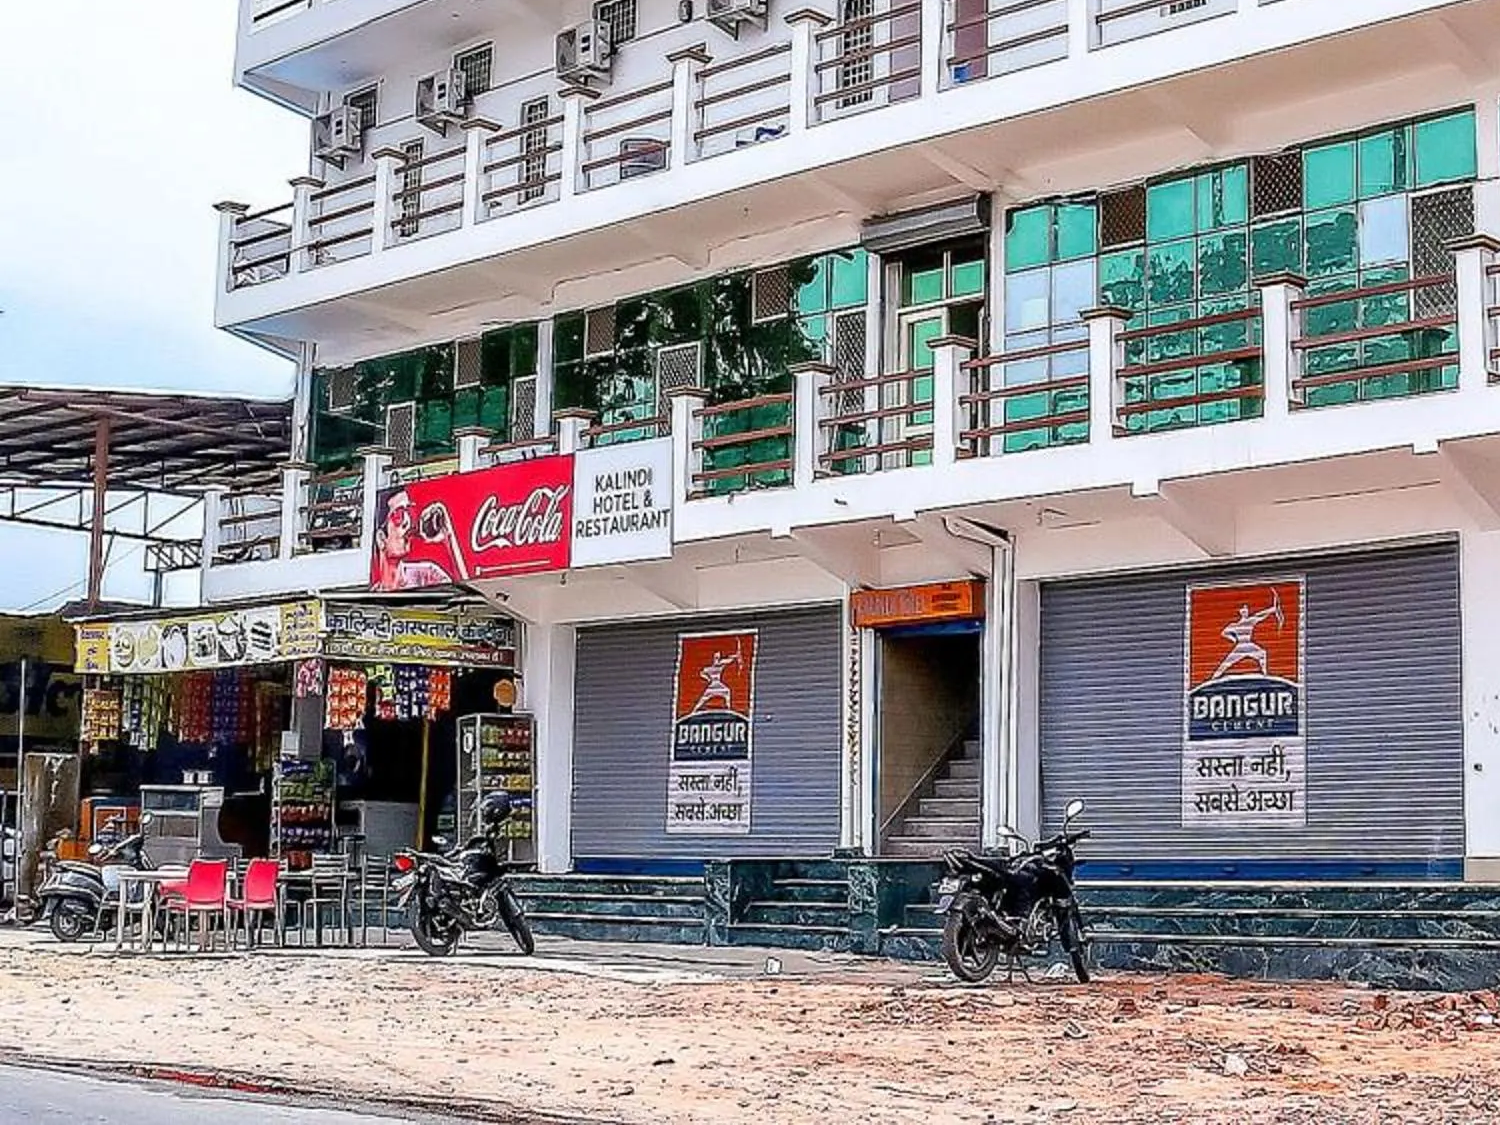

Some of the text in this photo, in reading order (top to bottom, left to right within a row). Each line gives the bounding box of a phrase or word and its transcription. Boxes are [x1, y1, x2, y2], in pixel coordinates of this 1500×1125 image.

[595, 468, 652, 493] KALINDI
[593, 489, 653, 515] HOTEL &
[575, 508, 671, 539] RESTAURANT
[1193, 692, 1294, 720] BANGUR
[677, 722, 747, 744] BANGUR
[1198, 755, 1244, 778] सस्ता
[1193, 783, 1295, 812] सबसे अच्छा
